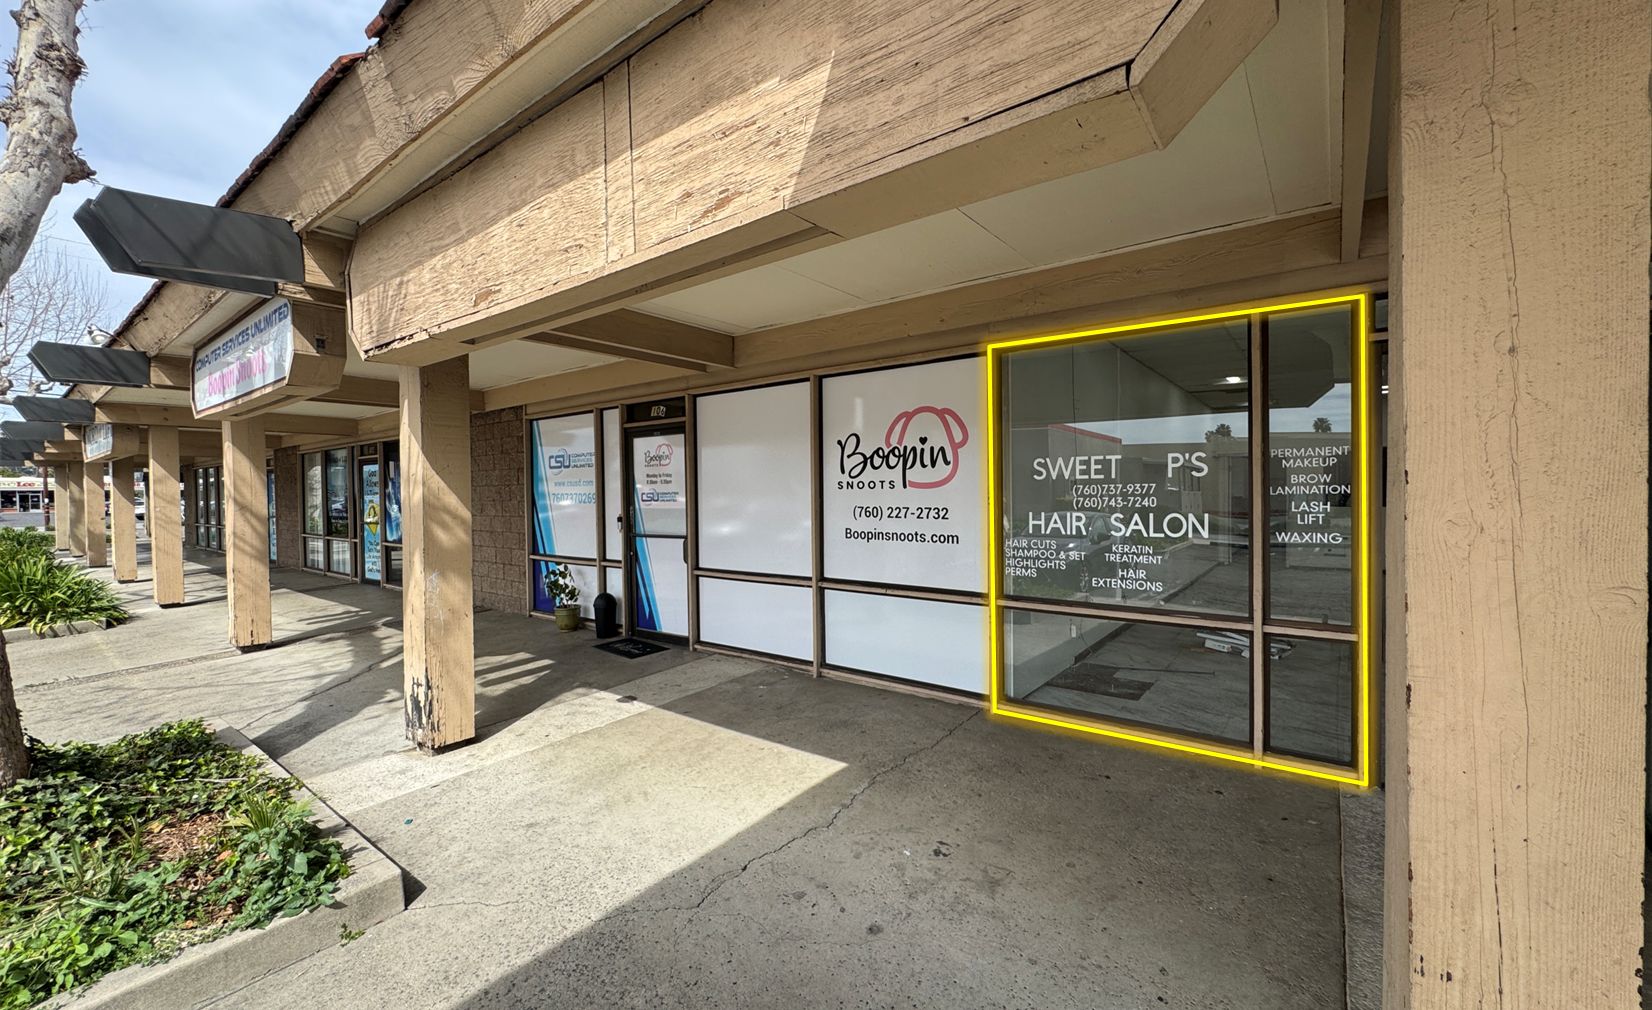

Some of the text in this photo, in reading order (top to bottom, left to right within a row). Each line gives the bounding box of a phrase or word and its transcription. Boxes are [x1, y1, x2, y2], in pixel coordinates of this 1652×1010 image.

[196, 303, 289, 372] COMPUTER SERVICES UNLIMITED
[208, 346, 267, 398] Boopin Snoots
[651, 406, 666, 416] 106
[1270, 445, 1350, 459] PERMANENT
[837, 433, 951, 489] Boopin
[1033, 451, 1209, 480] SWEET P'S
[1281, 456, 1338, 469] MAKEUP
[554, 479, 594, 487] www.csusd.com
[837, 480, 896, 490] SNOOTS
[1290, 473, 1333, 485] BROW
[1072, 483, 1156, 498] (760)737-9377
[1269, 484, 1351, 496] LAMINATION
[551, 492, 596, 504] 7607370269
[1072, 496, 1158, 510] (760)743-7240
[853, 505, 949, 521] (760) 227-2732
[1291, 501, 1331, 513] LASH
[1028, 511, 1209, 539] HAIR SALON
[1297, 513, 1325, 525] LIFT
[845, 527, 959, 545] Boopinsnoots.com
[1275, 531, 1343, 544] WAXING
[1005, 538, 1057, 550] HAIR CUTS
[1111, 544, 1153, 555] KERATIN
[1005, 548, 1086, 561] SHAMPOO & SET
[1104, 552, 1163, 565] TREATMENT
[1005, 558, 1067, 570] HIGHLIGHTS
[1005, 567, 1037, 578] PERMS
[1118, 568, 1147, 580] HAIR
[1091, 577, 1164, 592] EXTENSIONS
